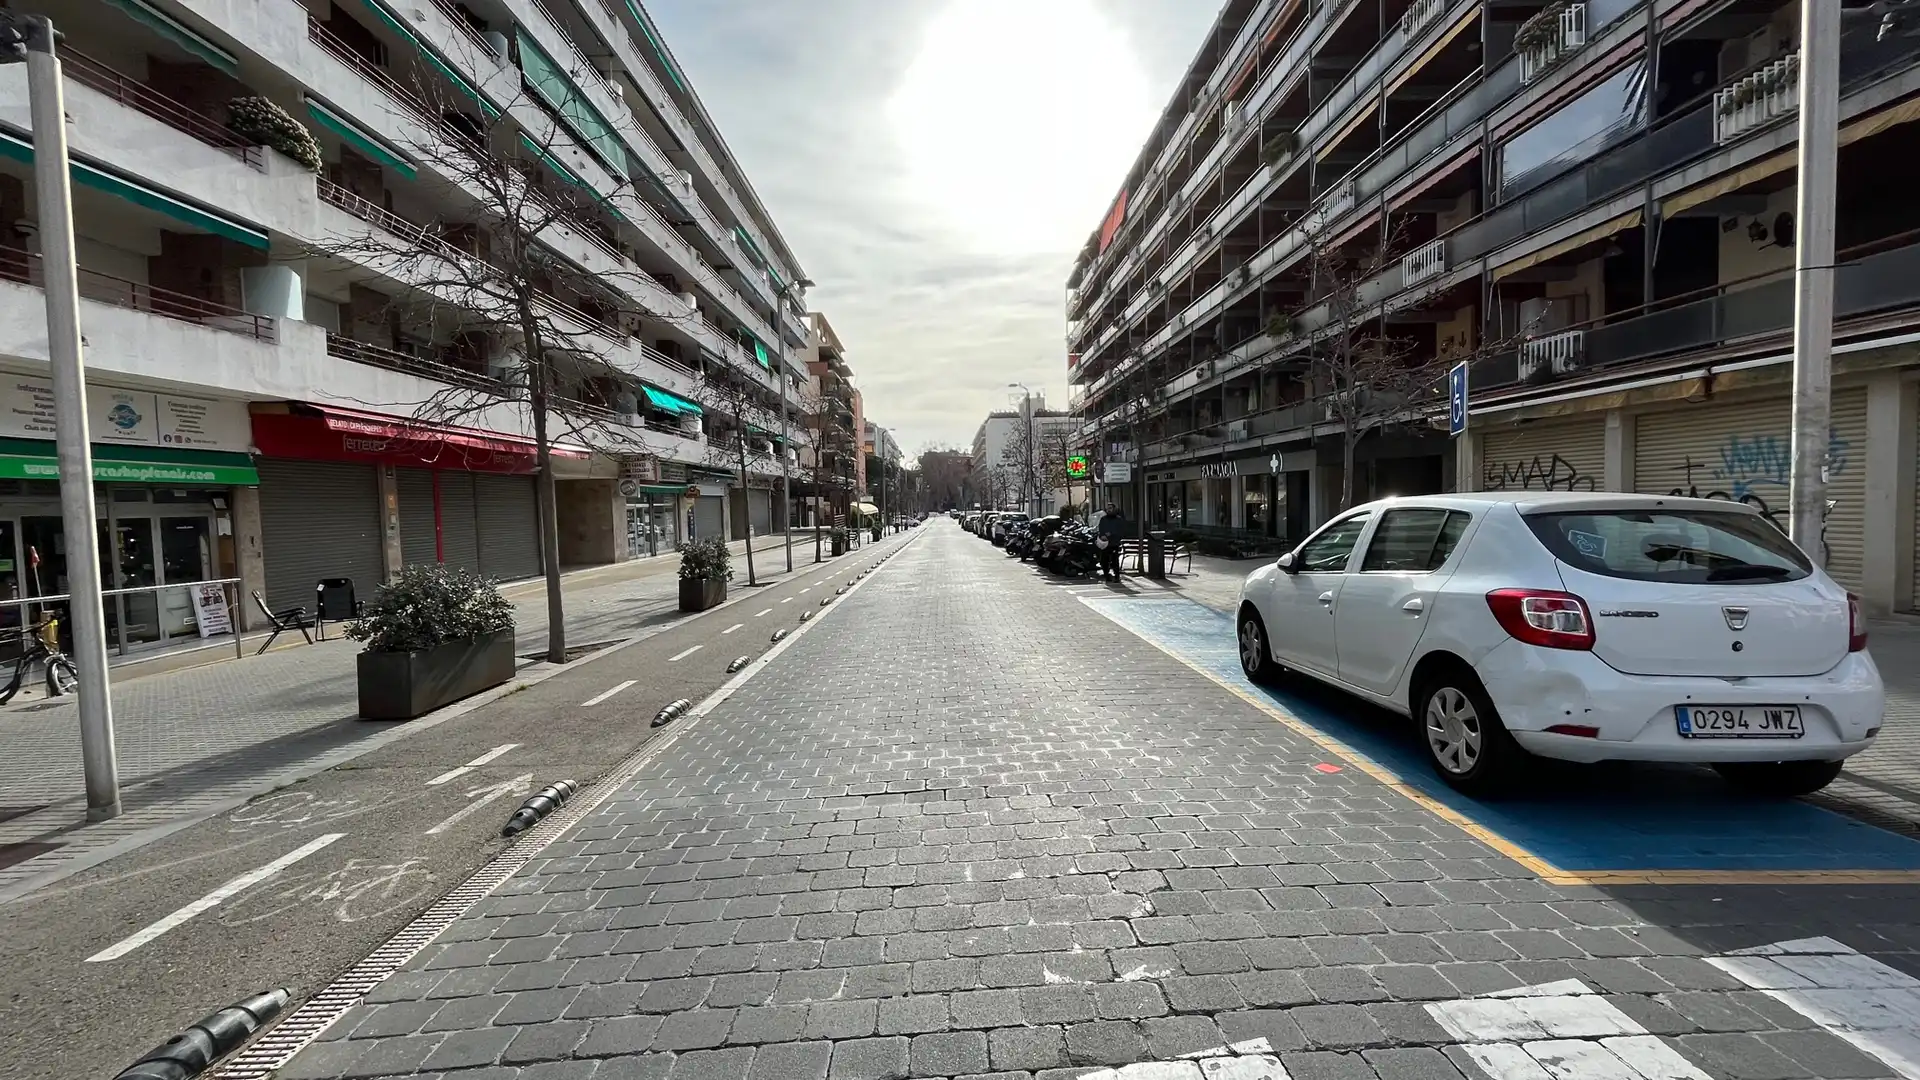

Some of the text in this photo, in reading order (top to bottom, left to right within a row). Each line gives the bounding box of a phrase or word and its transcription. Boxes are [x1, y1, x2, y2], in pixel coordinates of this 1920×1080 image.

[1201, 461, 1238, 479] FARMACIA
[1693, 709, 1799, 730] 0294 JWZ
